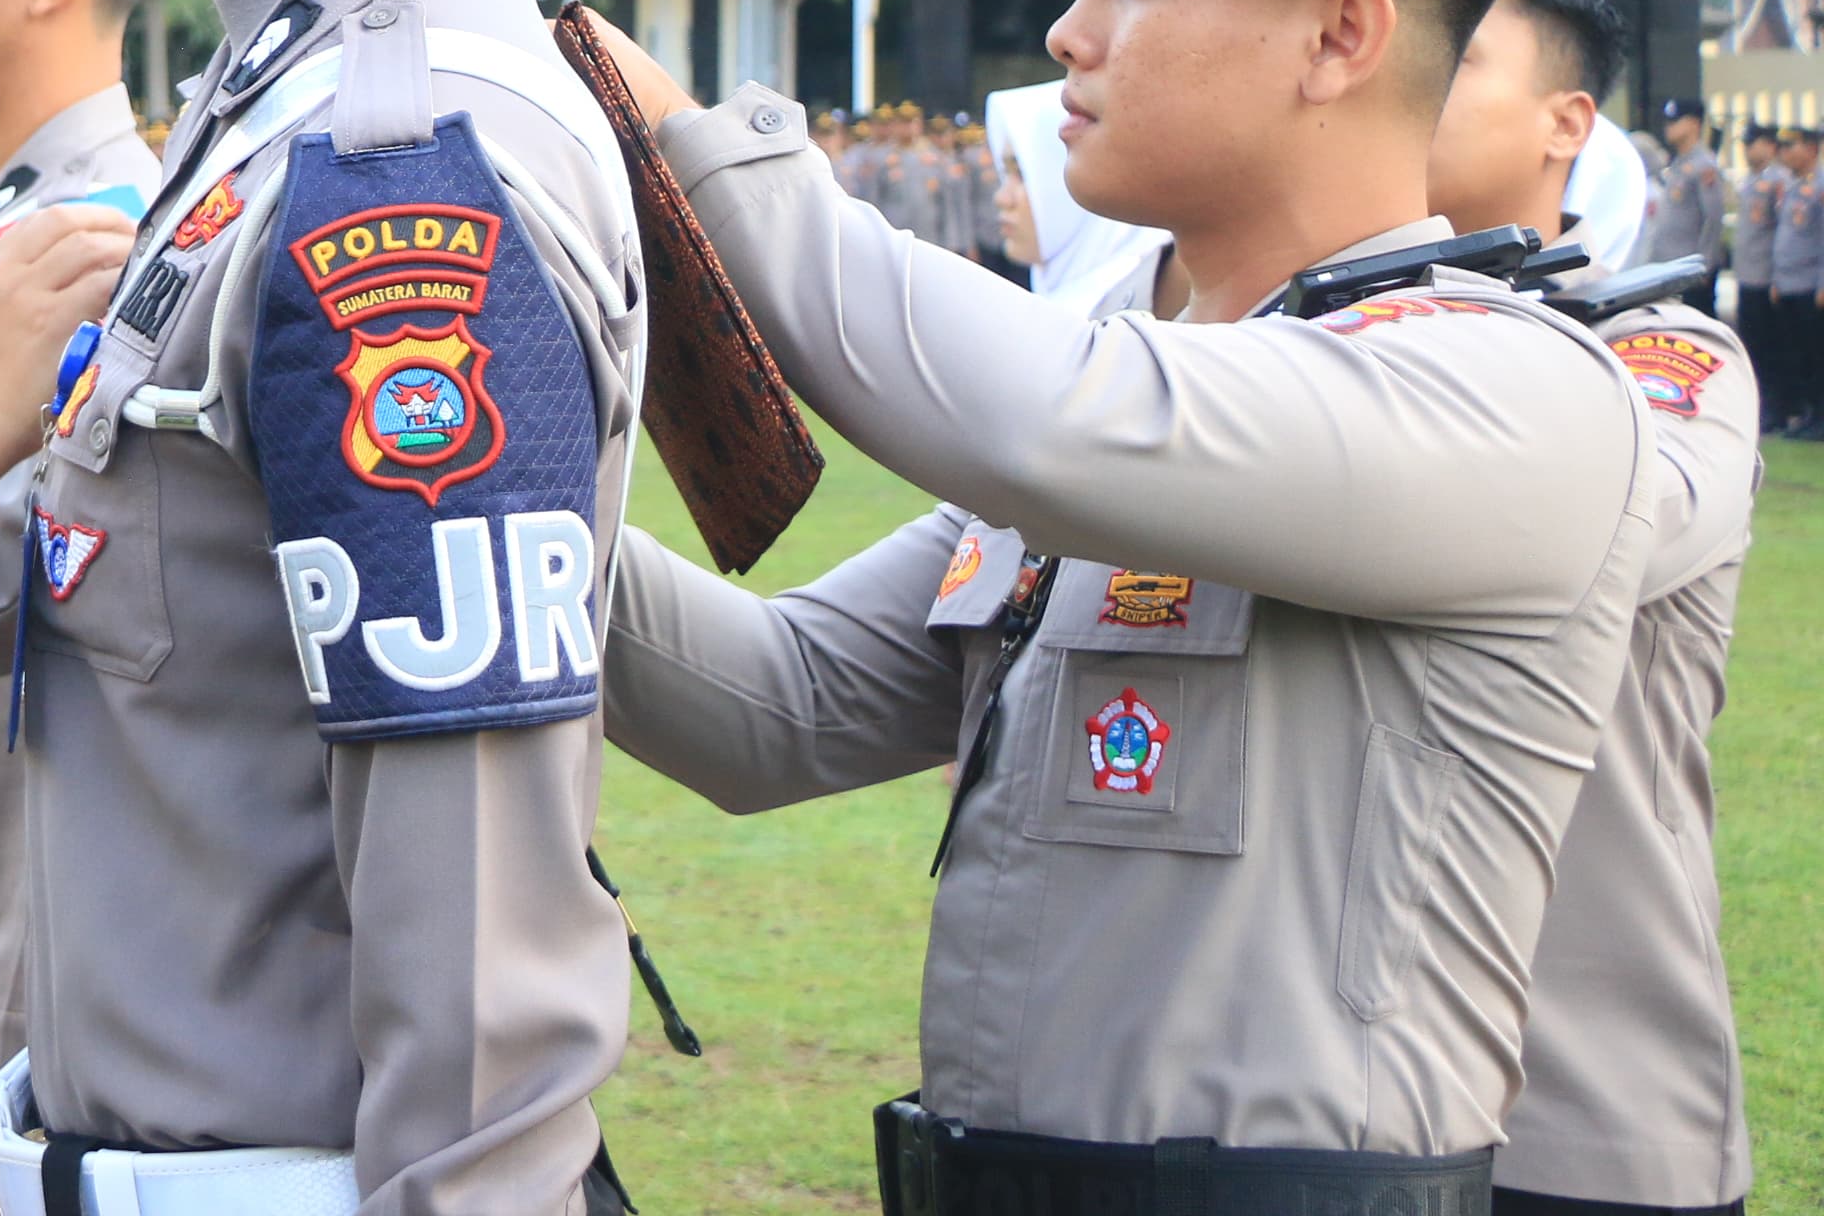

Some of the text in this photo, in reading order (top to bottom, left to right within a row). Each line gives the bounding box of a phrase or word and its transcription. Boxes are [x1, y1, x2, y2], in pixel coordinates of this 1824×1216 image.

[310, 217, 479, 276] POLDA
[337, 282, 472, 317] SUMATERA BARAT
[1612, 335, 1712, 367] POLDA
[276, 510, 600, 705] PJR
[1121, 608, 1162, 622] SNIPER
